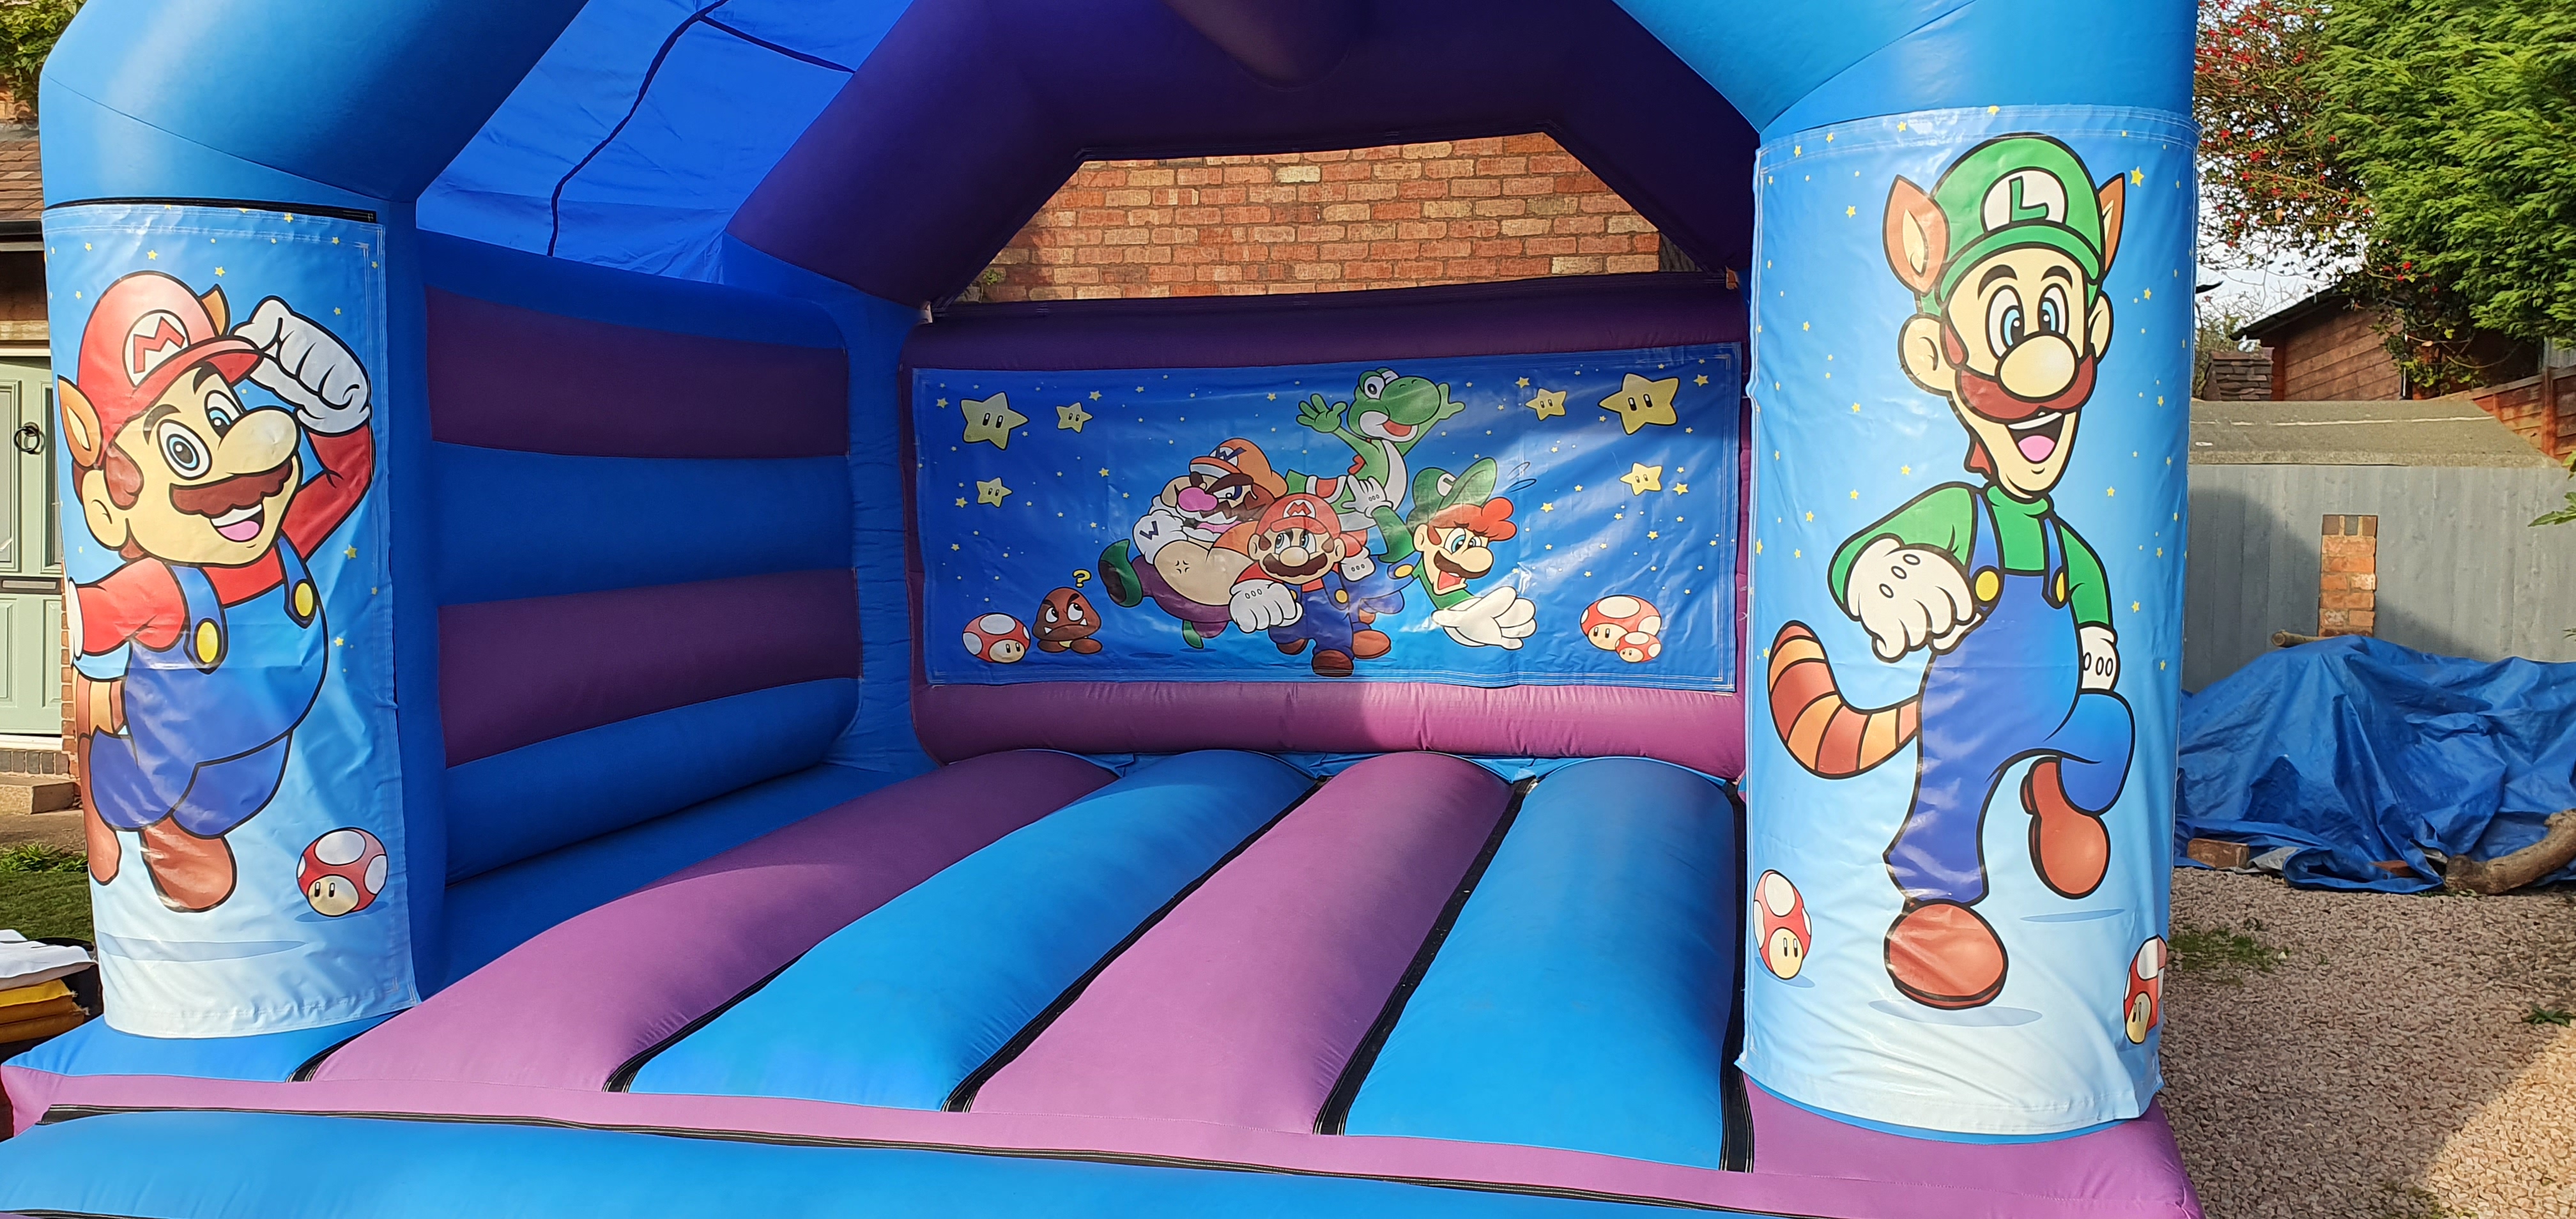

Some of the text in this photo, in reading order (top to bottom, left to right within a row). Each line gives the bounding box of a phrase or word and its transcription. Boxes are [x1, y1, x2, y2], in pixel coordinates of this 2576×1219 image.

[2009, 176, 2049, 222] L
[134, 316, 185, 374] M
[1215, 447, 1247, 461] W
[1286, 502, 1312, 516] M
[1139, 521, 1159, 540] W
[1072, 569, 1092, 588] ?
